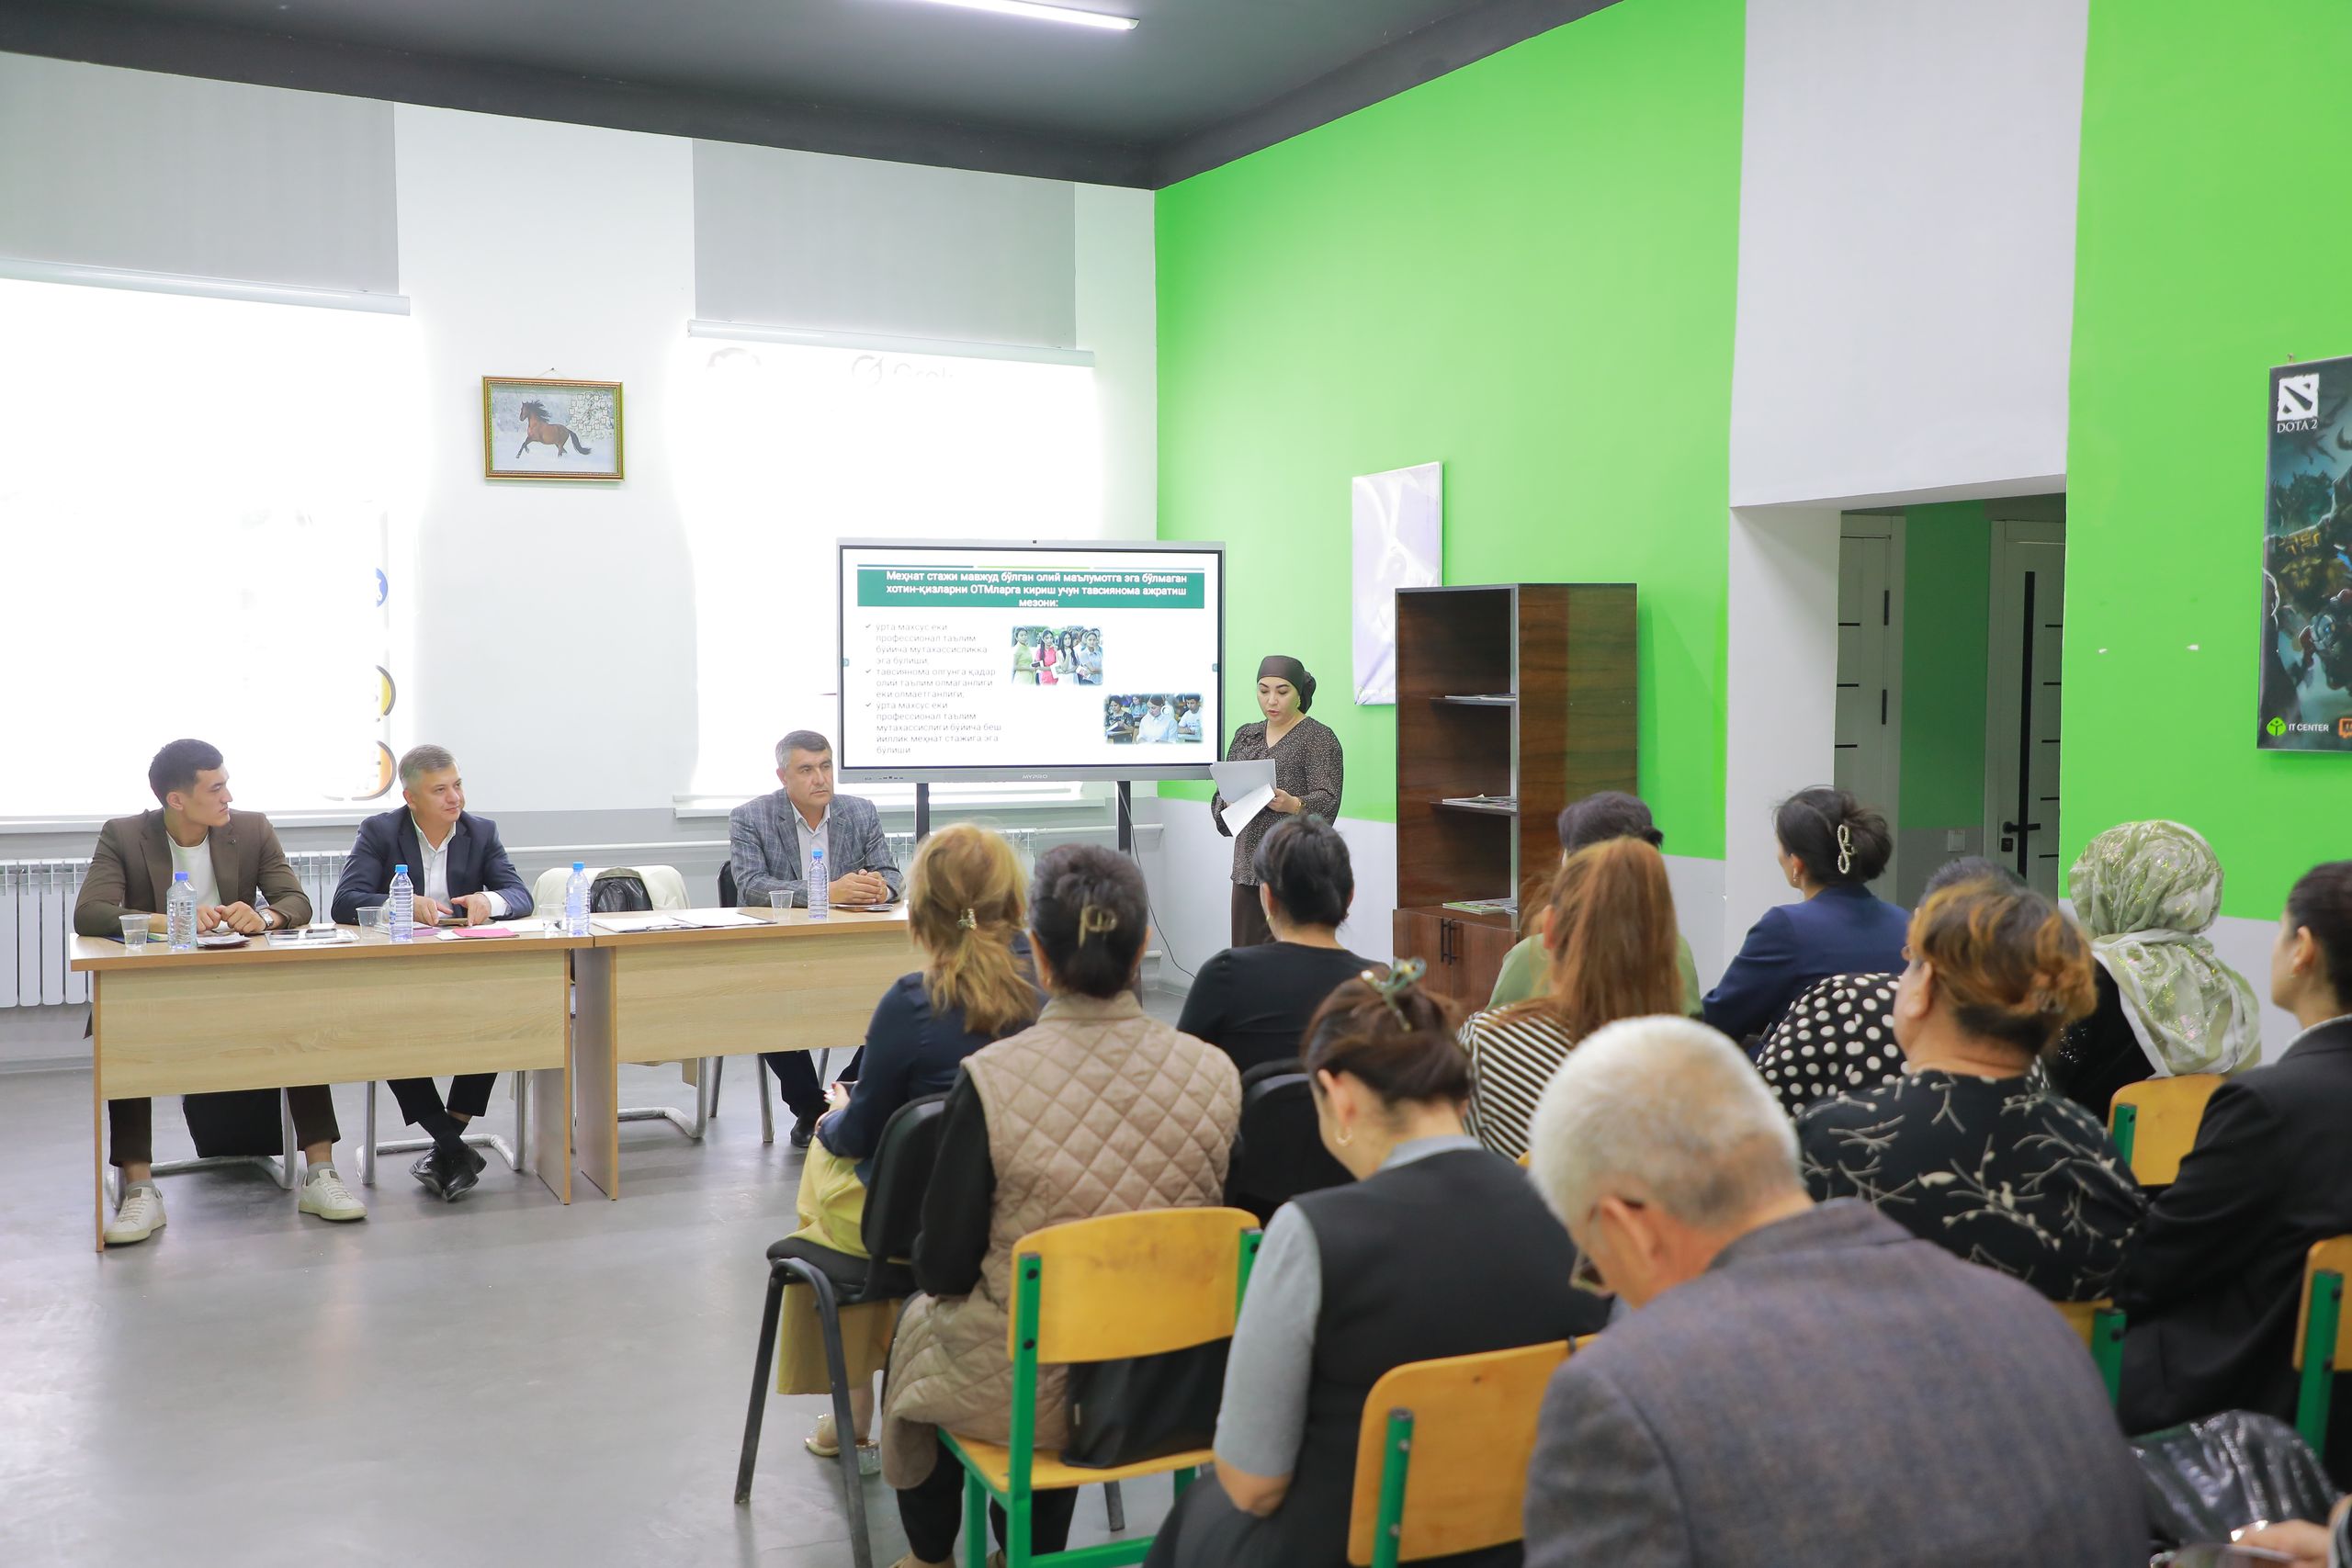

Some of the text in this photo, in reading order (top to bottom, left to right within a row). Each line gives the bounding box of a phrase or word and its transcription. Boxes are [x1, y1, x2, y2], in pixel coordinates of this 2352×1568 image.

[2277, 419, 2318, 434] DOTA 2
[886, 570, 924, 582] Меҳнат
[927, 572, 957, 581] стажи
[960, 572, 999, 583] мавжуд
[1001, 571, 1034, 583] бўлган
[1036, 572, 1060, 582] олий
[1063, 573, 1122, 584] маълумотга
[1142, 573, 1187, 584] бўлмаган
[886, 584, 1187, 597] хотин-қизларни ОТМларга кириш учун тавсиянома ажратиш
[1019, 599, 1058, 607] мезони:
[2297, 723, 2329, 732] CENTER
